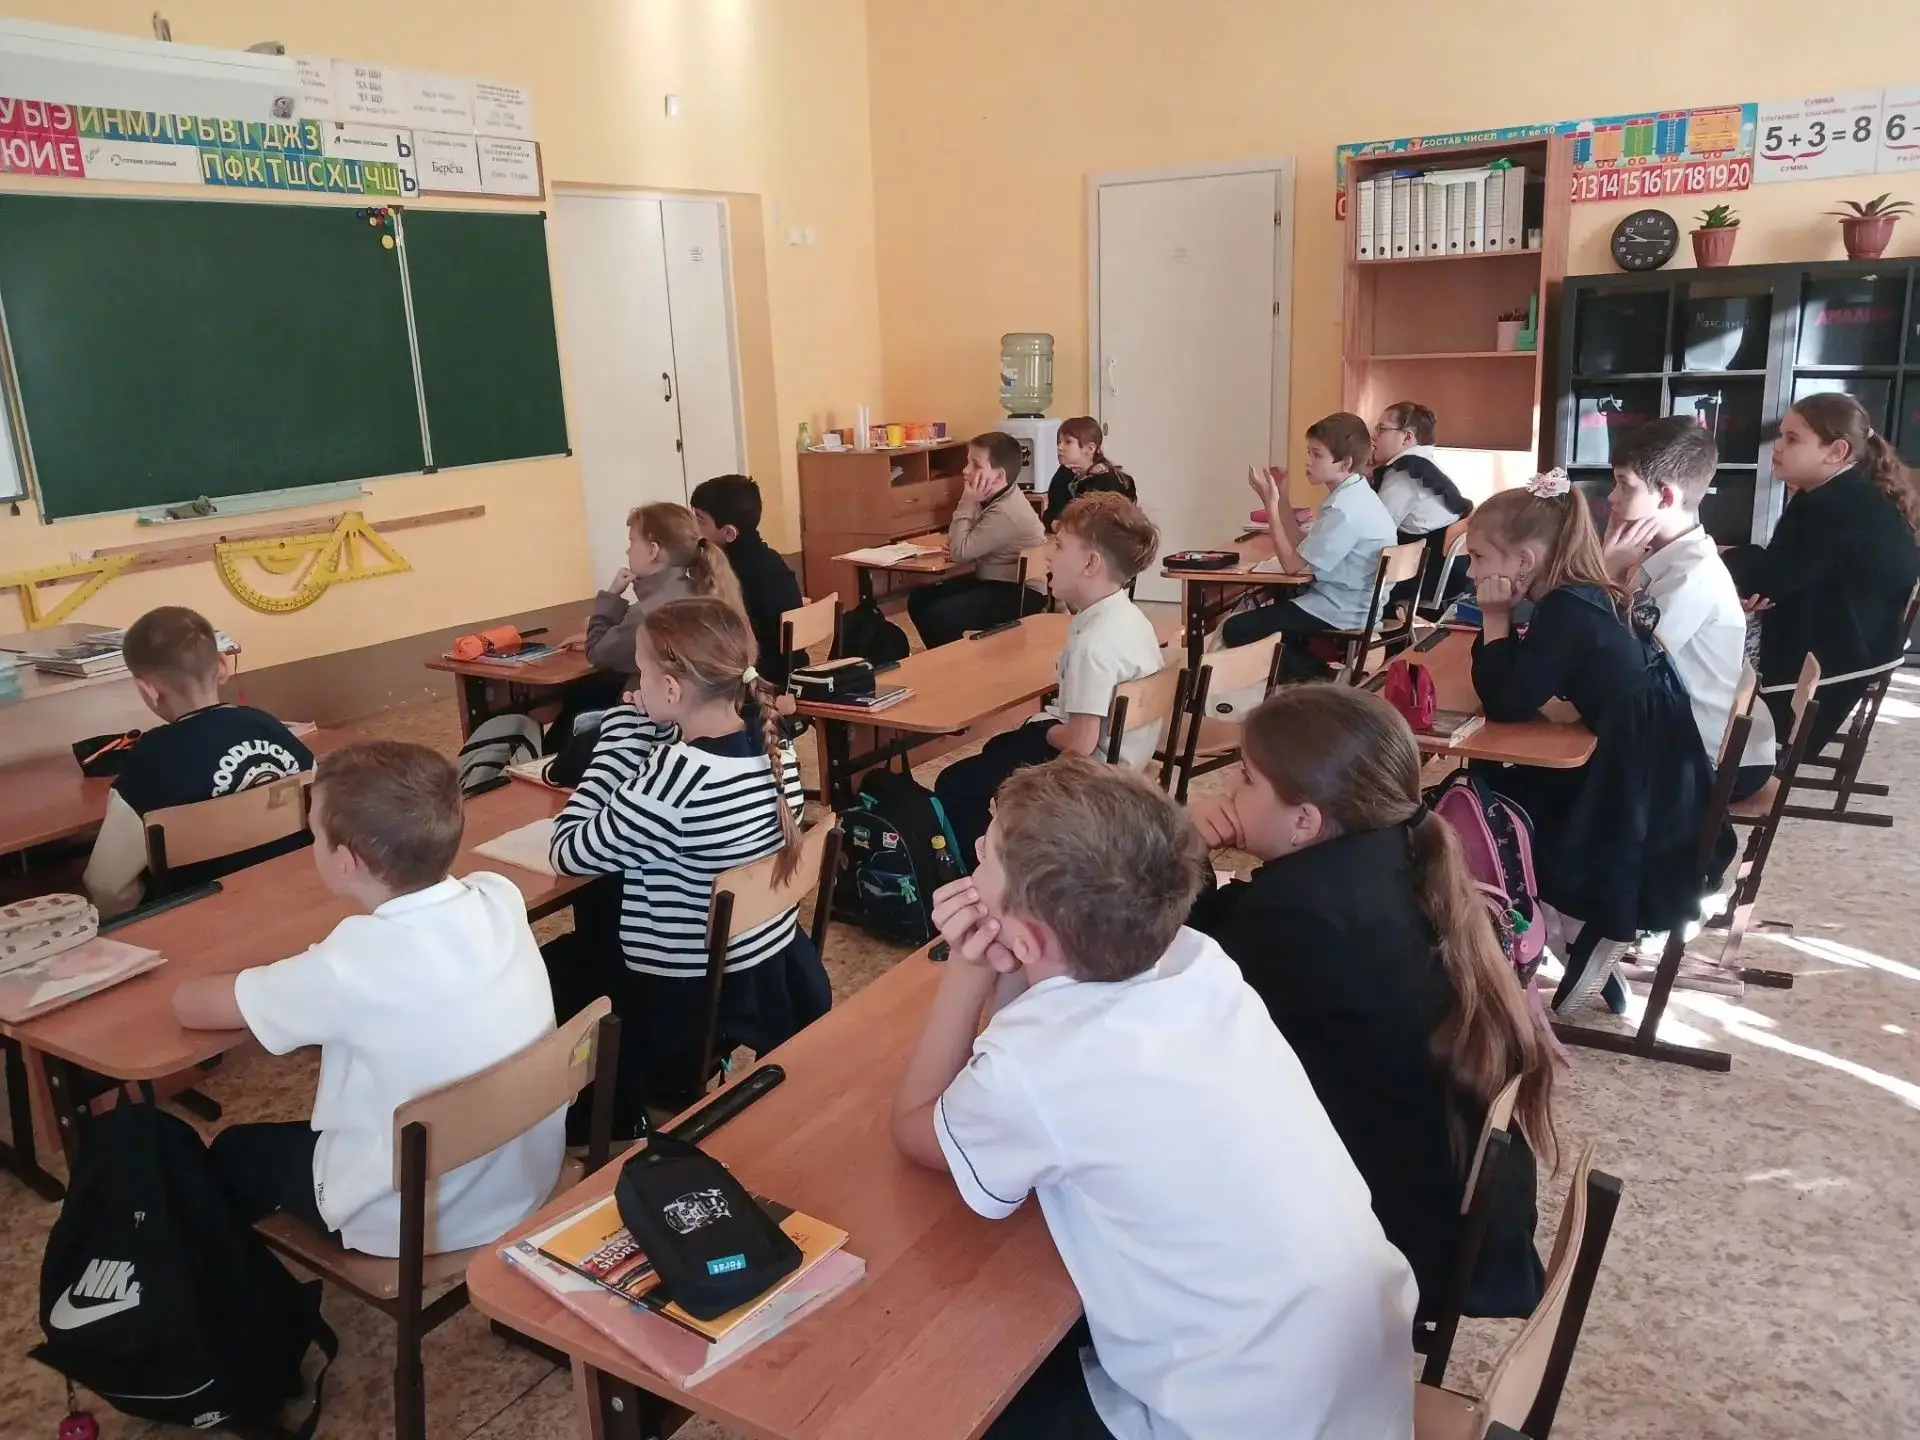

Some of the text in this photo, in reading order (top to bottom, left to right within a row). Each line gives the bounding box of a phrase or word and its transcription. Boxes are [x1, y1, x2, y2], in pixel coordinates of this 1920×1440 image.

[1421, 137, 1461, 149] СОСТАВ
[1464, 131, 1497, 145] ЧИСЕЛ
[432, 160, 464, 175] Берёза
[1579, 174, 1598, 199] 13
[1599, 173, 1618, 198] 14
[1620, 171, 1640, 196] 15
[1642, 169, 1661, 194] 16
[1664, 167, 1683, 193] 17
[1685, 165, 1704, 191] 18
[1706, 164, 1727, 189] 19
[1727, 162, 1750, 188] 20
[593, 1239, 631, 1265] AUTO
[599, 1242, 641, 1270] SPORT
[73, 1258, 142, 1300] NIK
